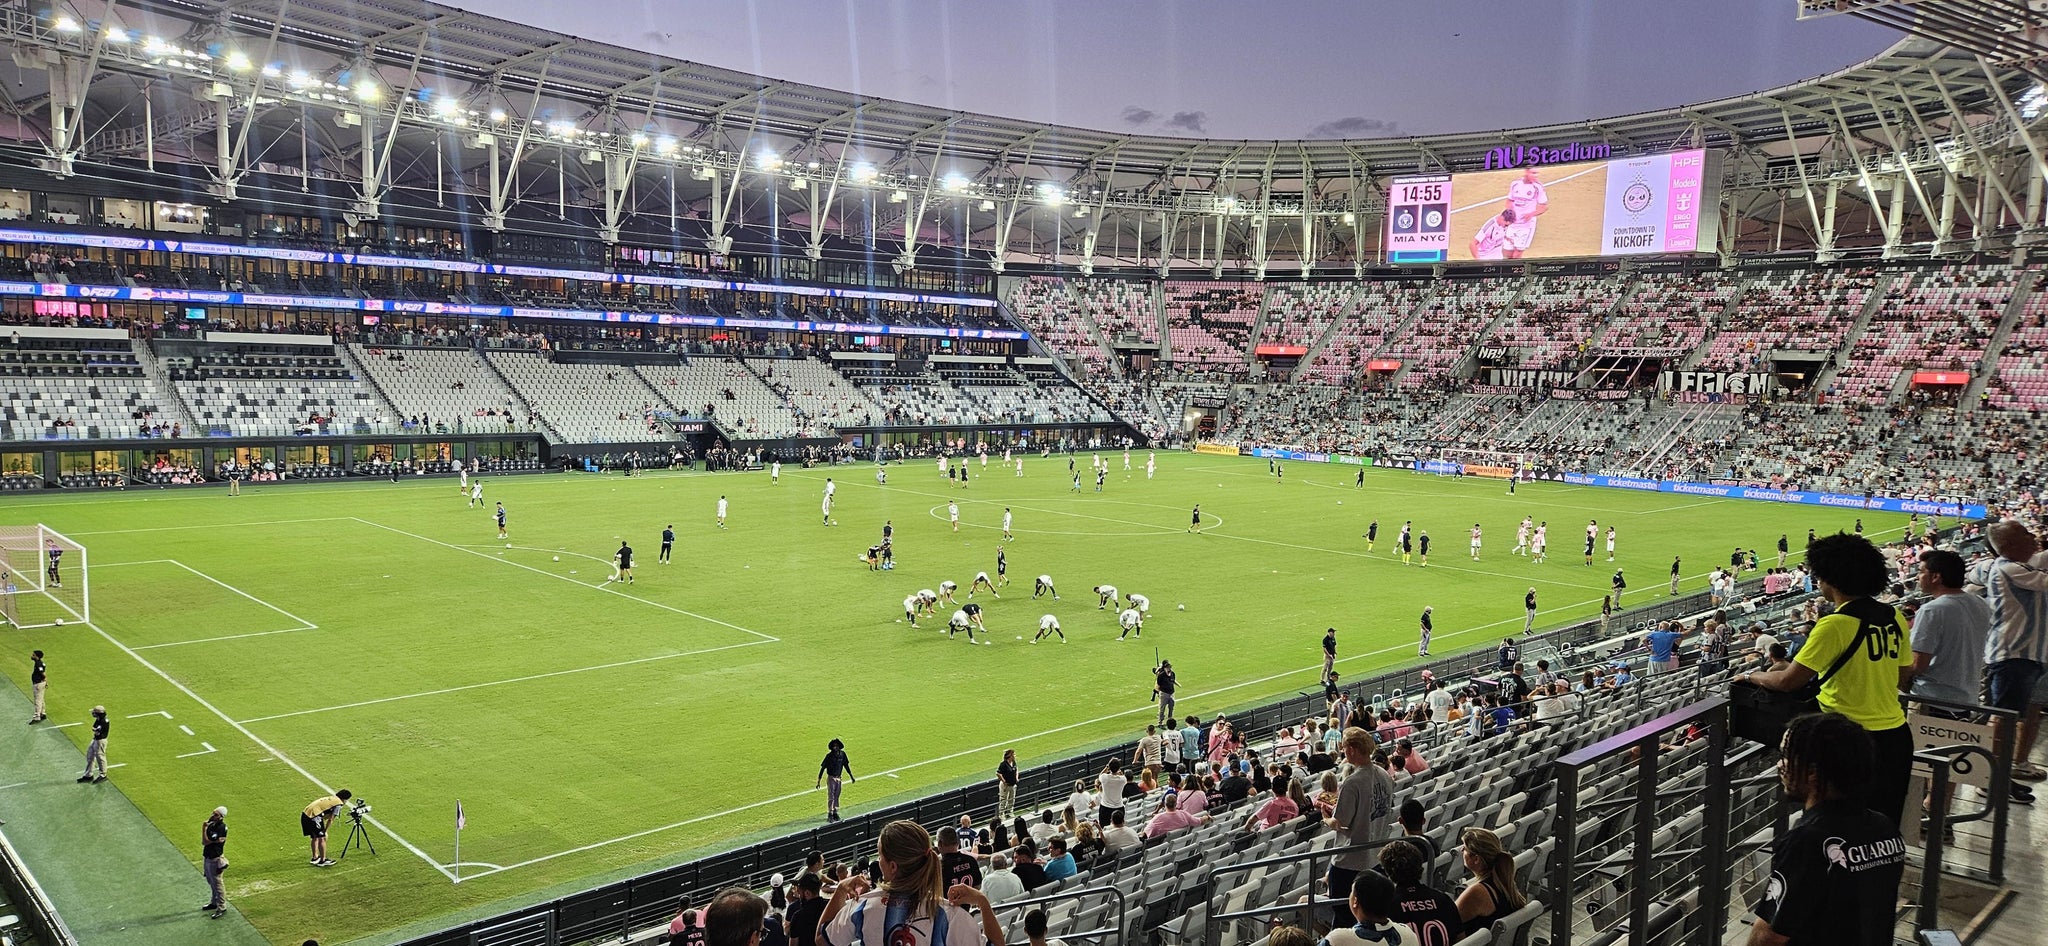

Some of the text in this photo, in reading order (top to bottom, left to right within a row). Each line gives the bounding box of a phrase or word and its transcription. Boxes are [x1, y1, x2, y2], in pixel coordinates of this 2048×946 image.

[1528, 141, 1611, 165] Stadium
[1674, 156, 1700, 168] HPE
[1402, 185, 1442, 202] 14:55
[1613, 226, 1647, 235] COUNTDOWN
[1420, 234, 1446, 242] NYC
[1613, 234, 1655, 248] KICKOFF
[1340, 456, 1363, 465] Publix
[1673, 483, 1730, 496] ticketmaster
[1920, 725, 1981, 744] SECTION
[953, 862, 971, 873] MESSI
[1400, 898, 1438, 913] MESSI
